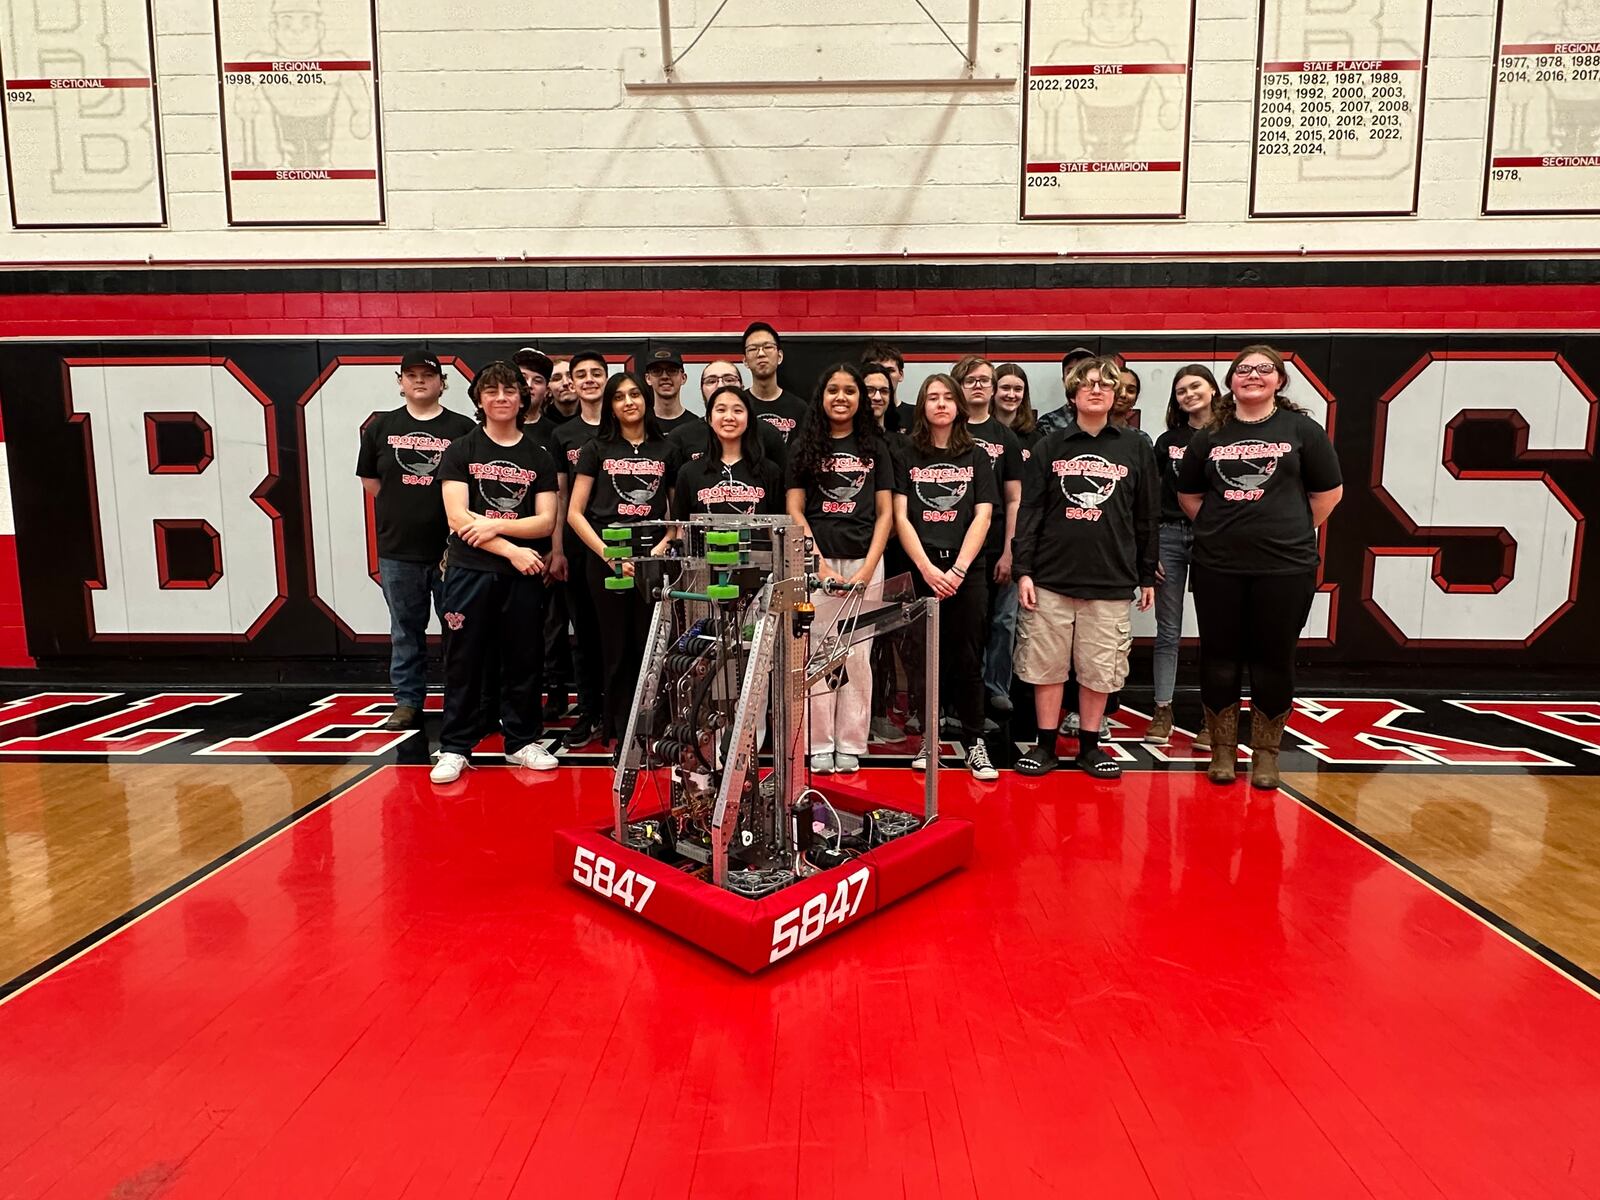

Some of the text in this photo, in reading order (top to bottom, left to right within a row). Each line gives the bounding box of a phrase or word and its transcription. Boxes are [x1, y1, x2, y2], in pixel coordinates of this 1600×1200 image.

[271, 62, 323, 72] REGIONAL
[1303, 61, 1382, 72] STATE PLAYOFF
[1501, 57, 1530, 69] 1977,
[1536, 56, 1566, 68] 1978,
[1093, 65, 1123, 75] STATE
[225, 74, 327, 86] 1998, 2006, 2015,
[1263, 73, 1402, 87] 1975, 1982, 1987, 1989,
[1499, 71, 1531, 83] 2014,
[1536, 70, 1567, 82] 2016,
[50, 79, 104, 89] SECTIONAL
[1030, 79, 1098, 91] 2022, 2023,
[7, 91, 36, 103] 1992,
[1263, 87, 1406, 100] 1991, 1992, 2000, 2003,
[1261, 101, 1412, 114] 2004, 2005, 2007, 2008,
[1260, 115, 1402, 128] 2009, 2010, 2012, 2013,
[1259, 129, 1403, 142] 2014, 2015, 2016, 2022,
[1059, 162, 1149, 173] STATE CHAMPION
[1542, 157, 1600, 167] SECTIONAL
[275, 170, 331, 180] SECTIONAL
[1492, 169, 1522, 181] 1978,
[1027, 177, 1061, 188] 2023,
[387, 435, 452, 449] IRONCLAD
[468, 463, 537, 481] IRONCLAD
[1052, 460, 1129, 477] IRONCLAD
[402, 474, 434, 486] 5847
[697, 485, 765, 502] IRONCLAD
[1224, 489, 1265, 501] 5847
[618, 503, 652, 516] 5847
[822, 501, 857, 513] 5847
[485, 509, 518, 521] 5847
[922, 510, 958, 522] 5847
[1065, 507, 1102, 521] 5847
[572, 845, 657, 914] 5847
[768, 867, 871, 963] 5847
